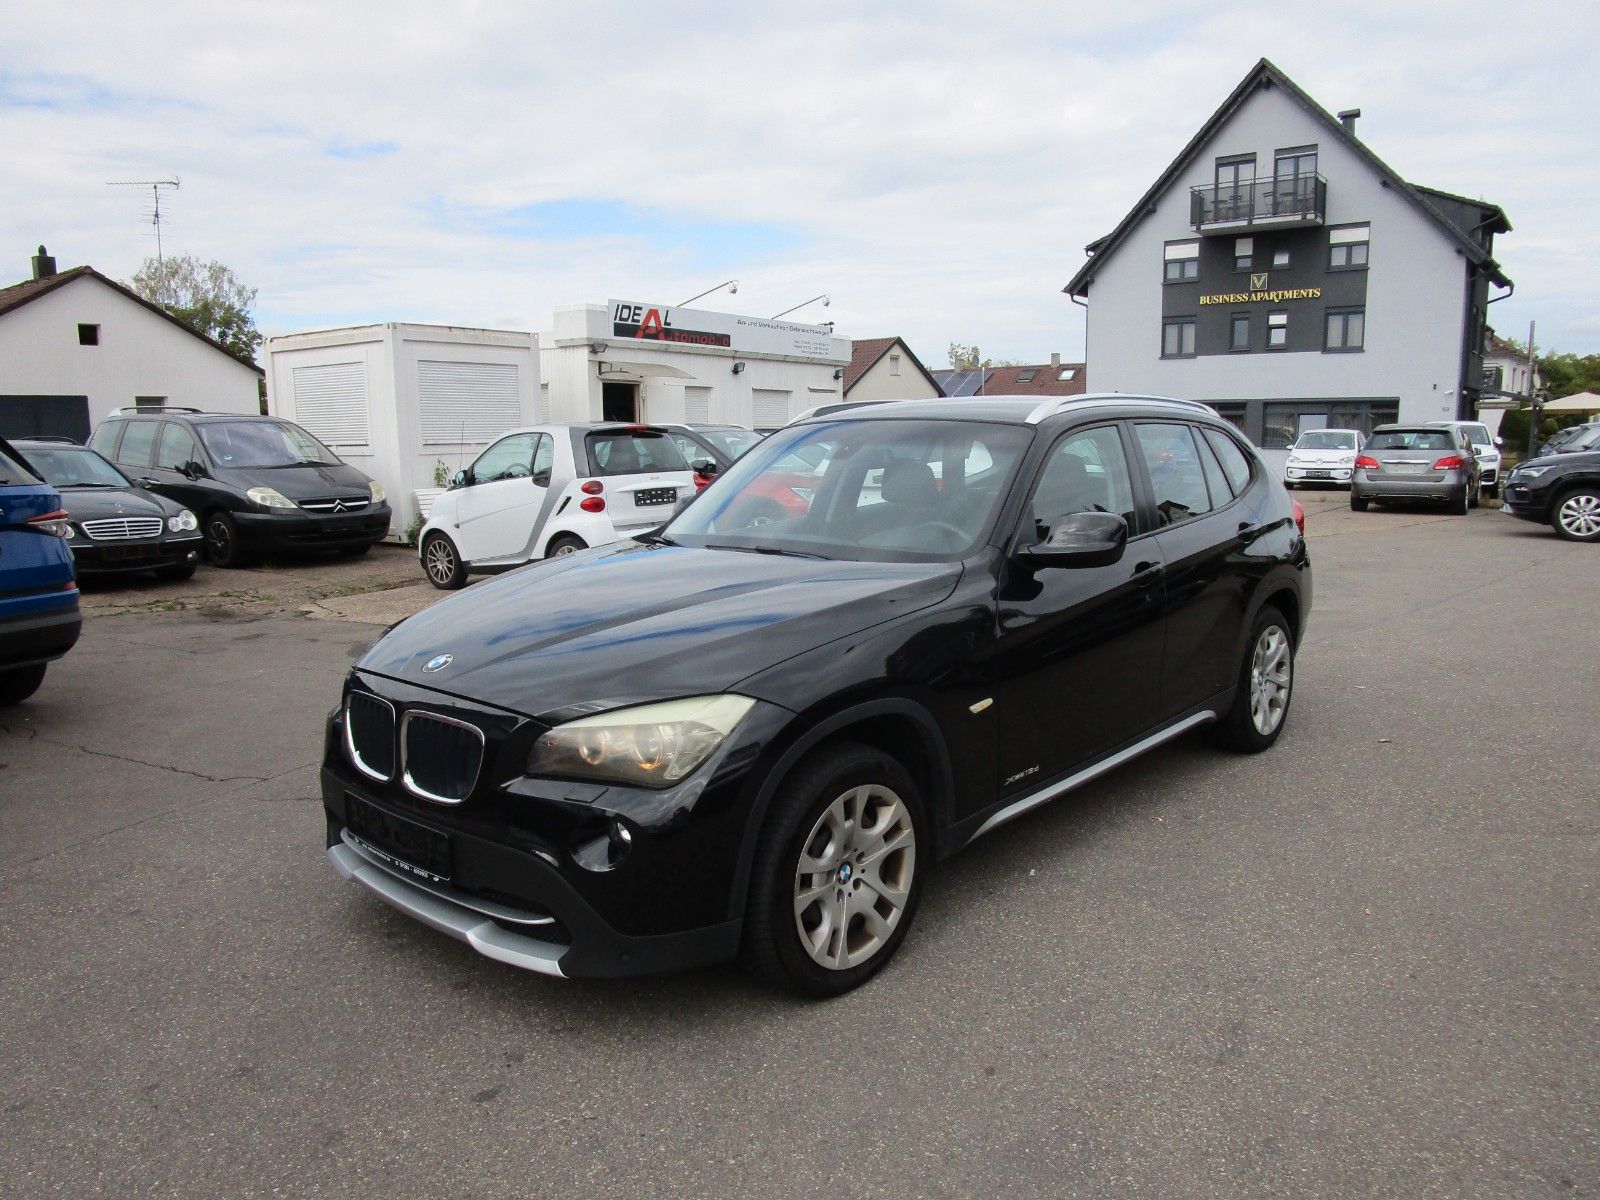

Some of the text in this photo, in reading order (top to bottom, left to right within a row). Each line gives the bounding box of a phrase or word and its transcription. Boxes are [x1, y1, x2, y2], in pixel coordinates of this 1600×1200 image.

[1199, 288, 1321, 305] BUSINESS APARTMENTS
[613, 303, 672, 341] IDEAL
